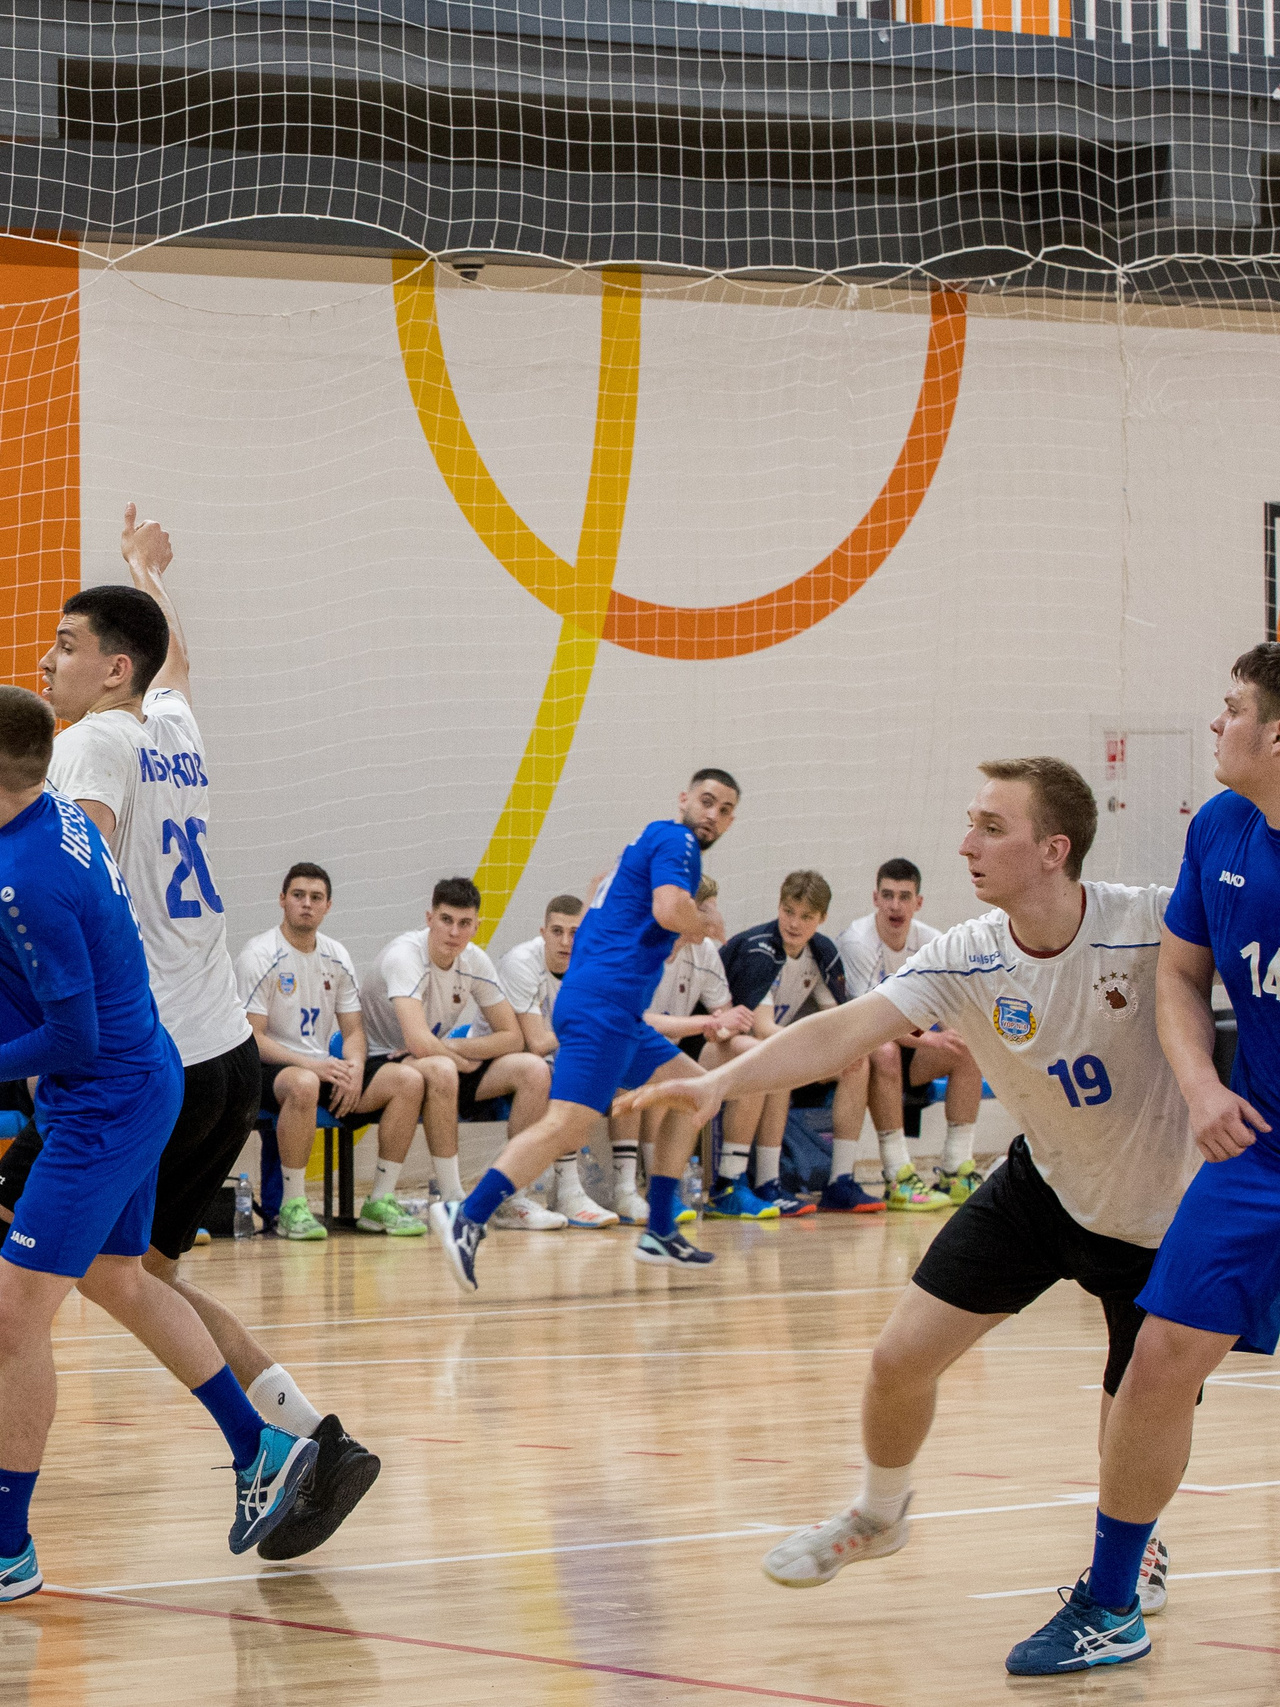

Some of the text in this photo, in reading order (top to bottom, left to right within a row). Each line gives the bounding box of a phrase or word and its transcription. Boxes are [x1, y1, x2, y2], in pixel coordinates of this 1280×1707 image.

[162, 816, 225, 919] 20
[1219, 870, 1246, 888] JAKO
[1239, 940, 1280, 1003] 14
[300, 1007, 321, 1037] 27
[1047, 1054, 1113, 1108] 19
[10, 1230, 37, 1249] JAKO
